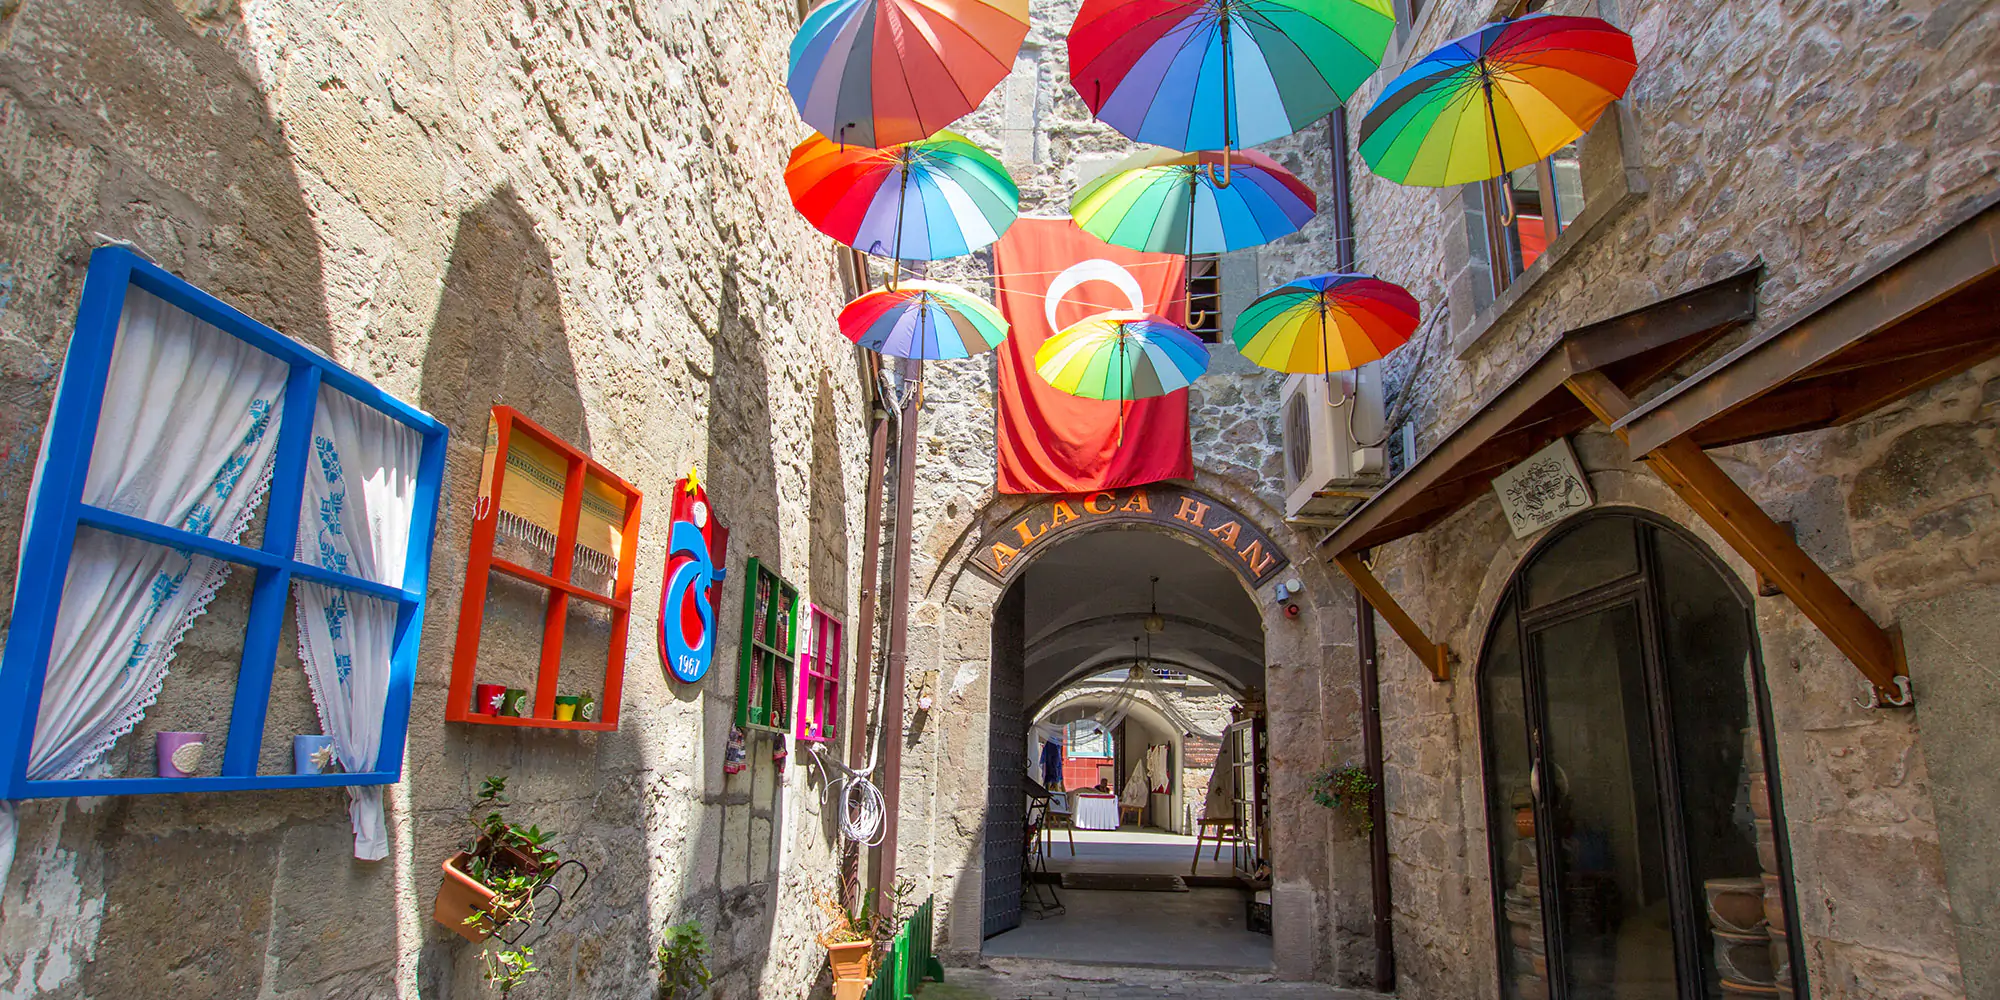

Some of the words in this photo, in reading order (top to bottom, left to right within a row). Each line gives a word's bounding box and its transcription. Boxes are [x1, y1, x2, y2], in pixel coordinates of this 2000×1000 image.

[990, 489, 1153, 573] ALACA
[1174, 495, 1276, 578] HAN
[678, 654, 701, 677] 1967
